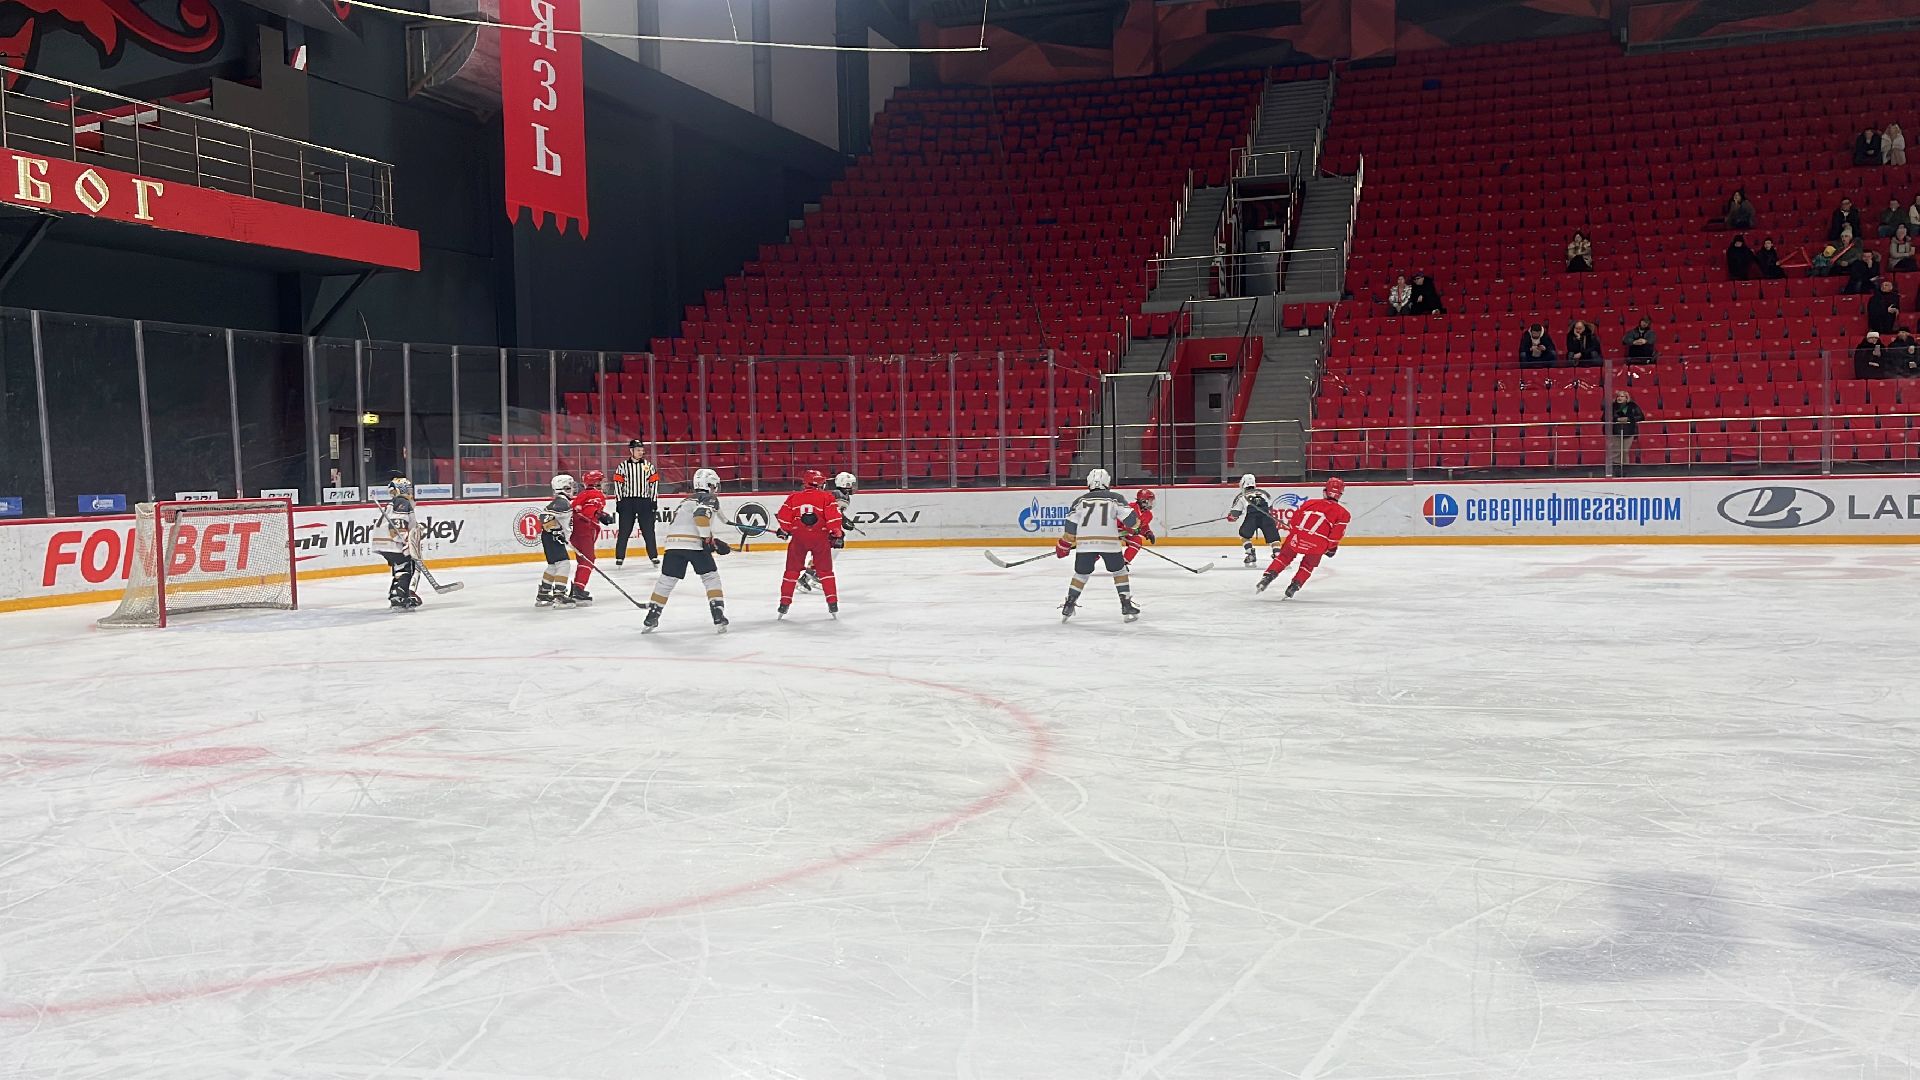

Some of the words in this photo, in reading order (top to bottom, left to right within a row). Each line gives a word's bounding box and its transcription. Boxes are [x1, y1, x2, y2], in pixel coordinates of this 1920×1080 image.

[12, 155, 164, 221] БОГ
[853, 511, 920, 523] DAI
[1041, 507, 1070, 518] ГАЗПР
[1082, 502, 1108, 526] 71
[1466, 493, 1681, 526] севернефтегазпром
[335, 516, 464, 544] Marckey
[1296, 511, 1326, 535] 17
[343, 547, 371, 558] MAKE
